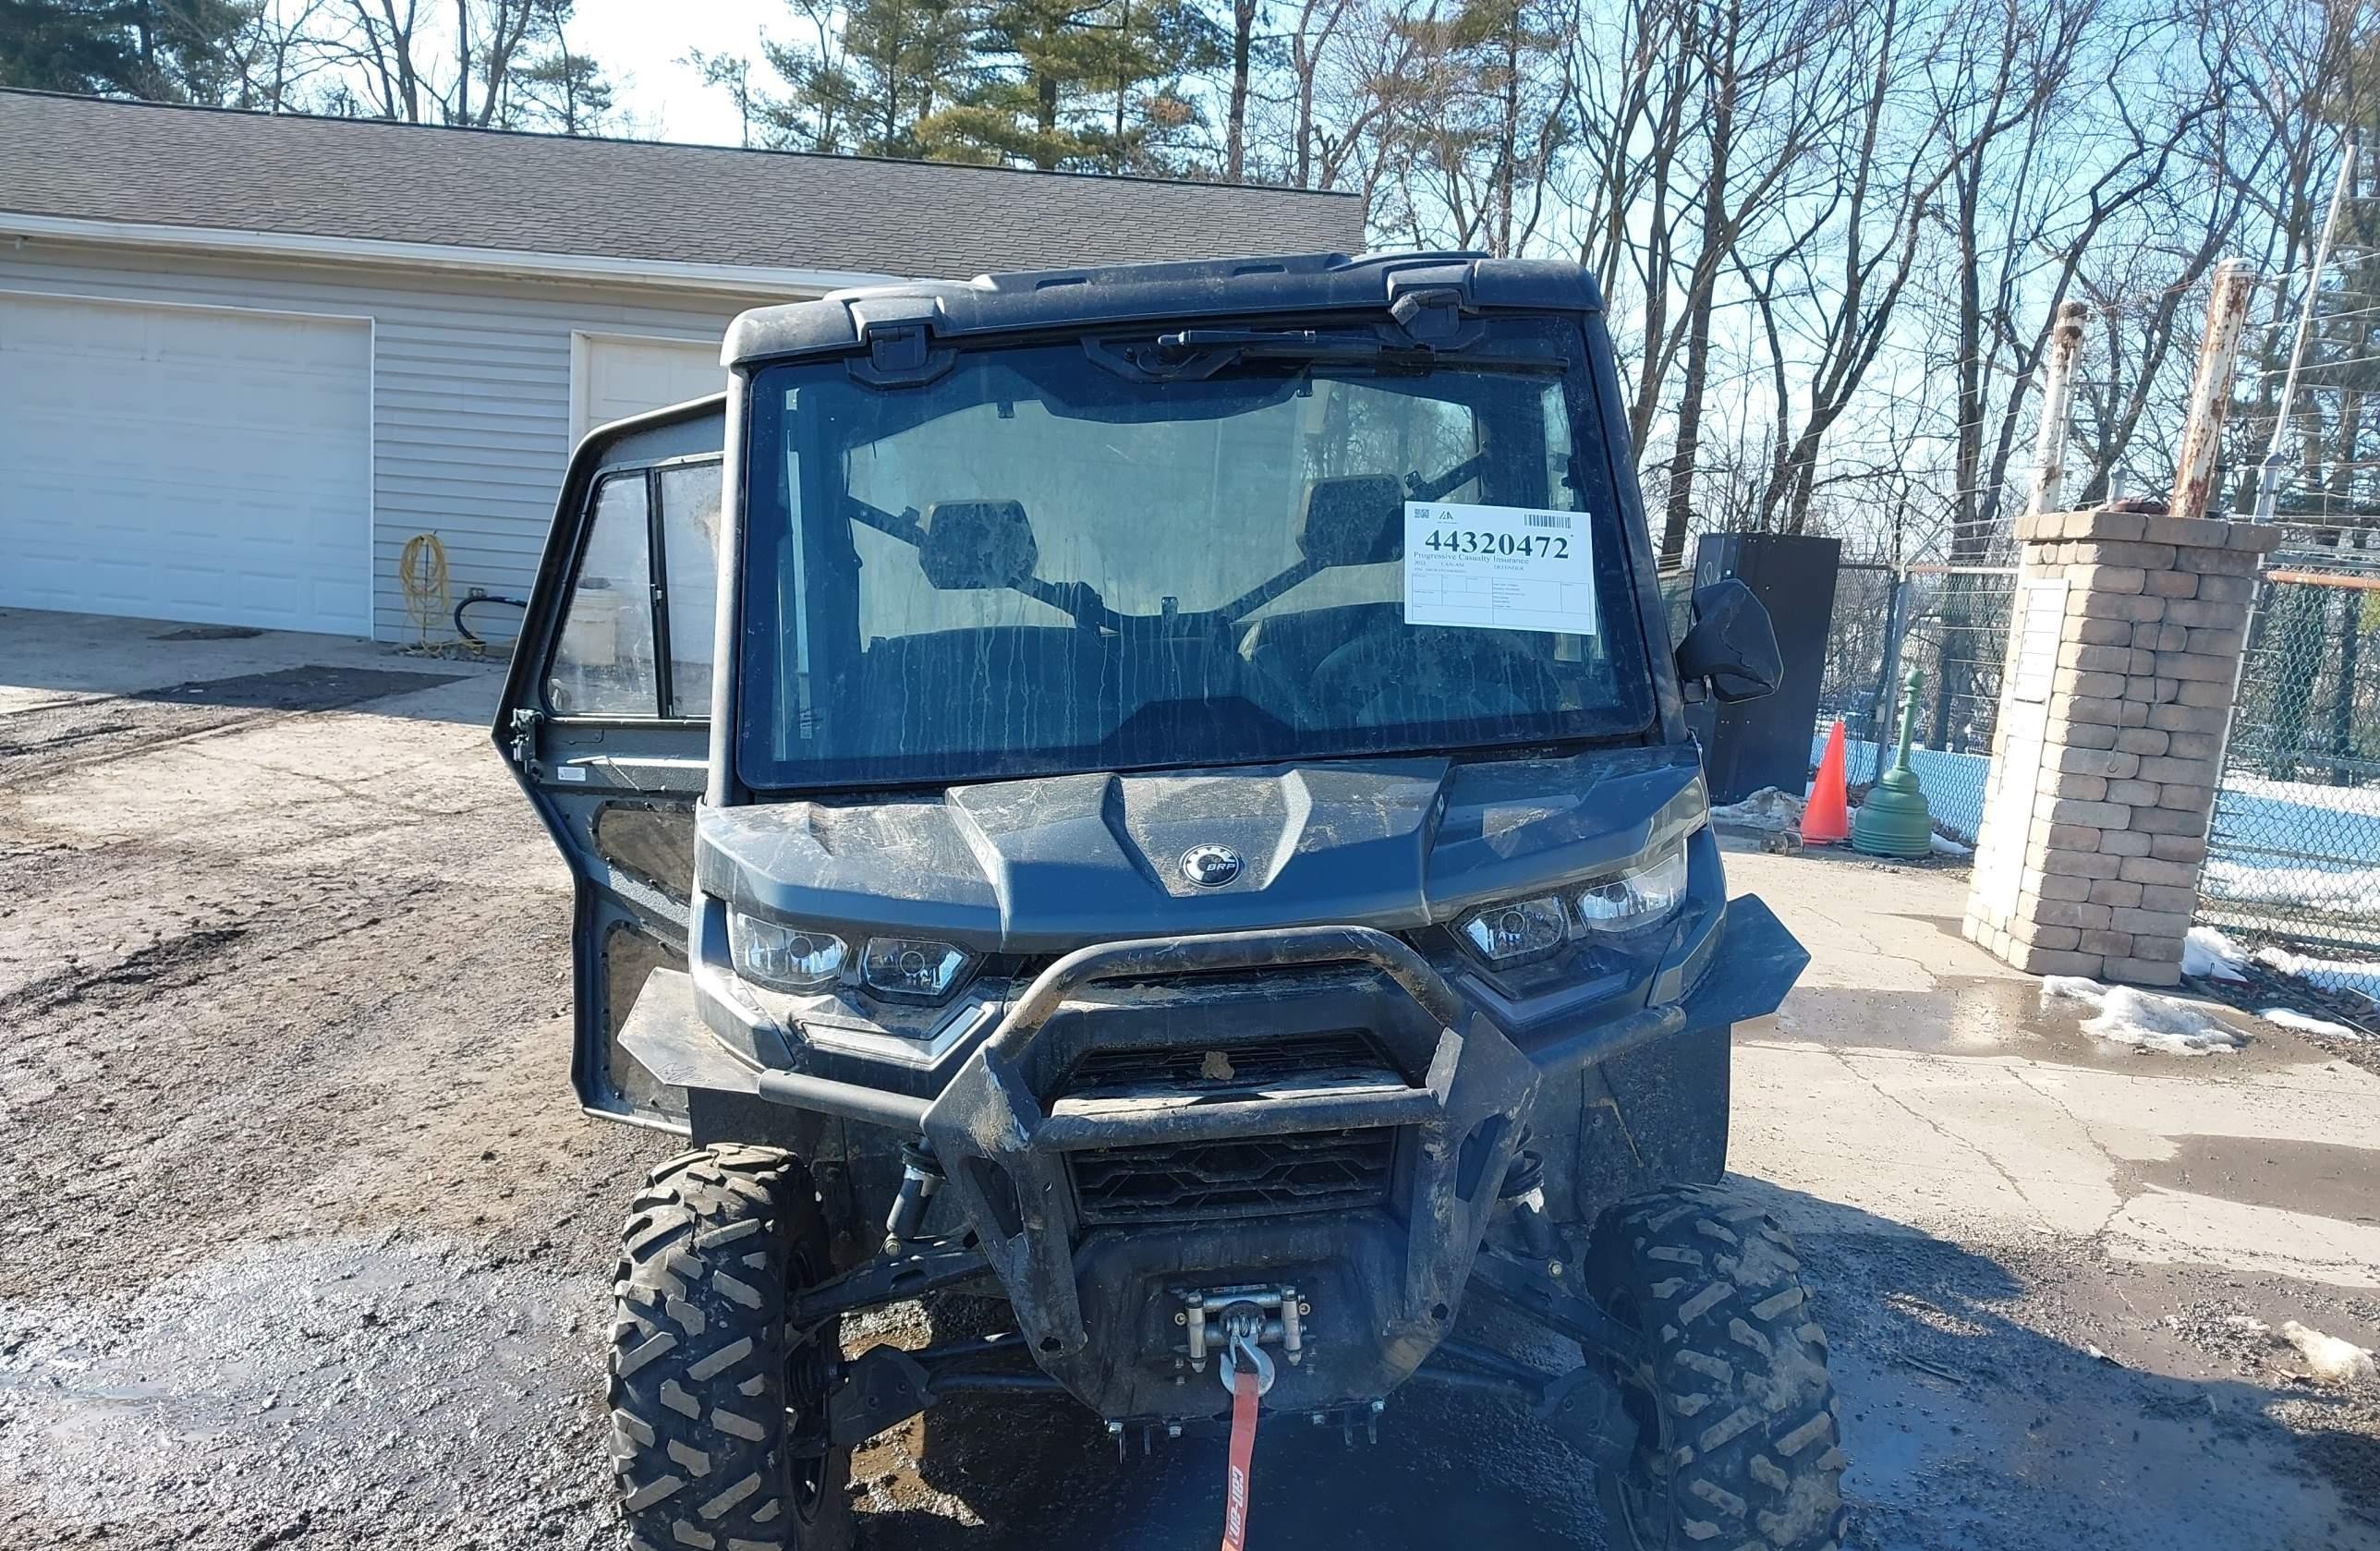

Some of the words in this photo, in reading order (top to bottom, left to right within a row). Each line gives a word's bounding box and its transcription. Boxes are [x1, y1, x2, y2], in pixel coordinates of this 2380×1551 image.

[1425, 529, 1569, 559] 44320472
[1414, 551, 1457, 561] Progressive
[1458, 554, 1490, 563] Casualty
[1493, 555, 1530, 564] Insurance
[1207, 863, 1236, 871] BRP
